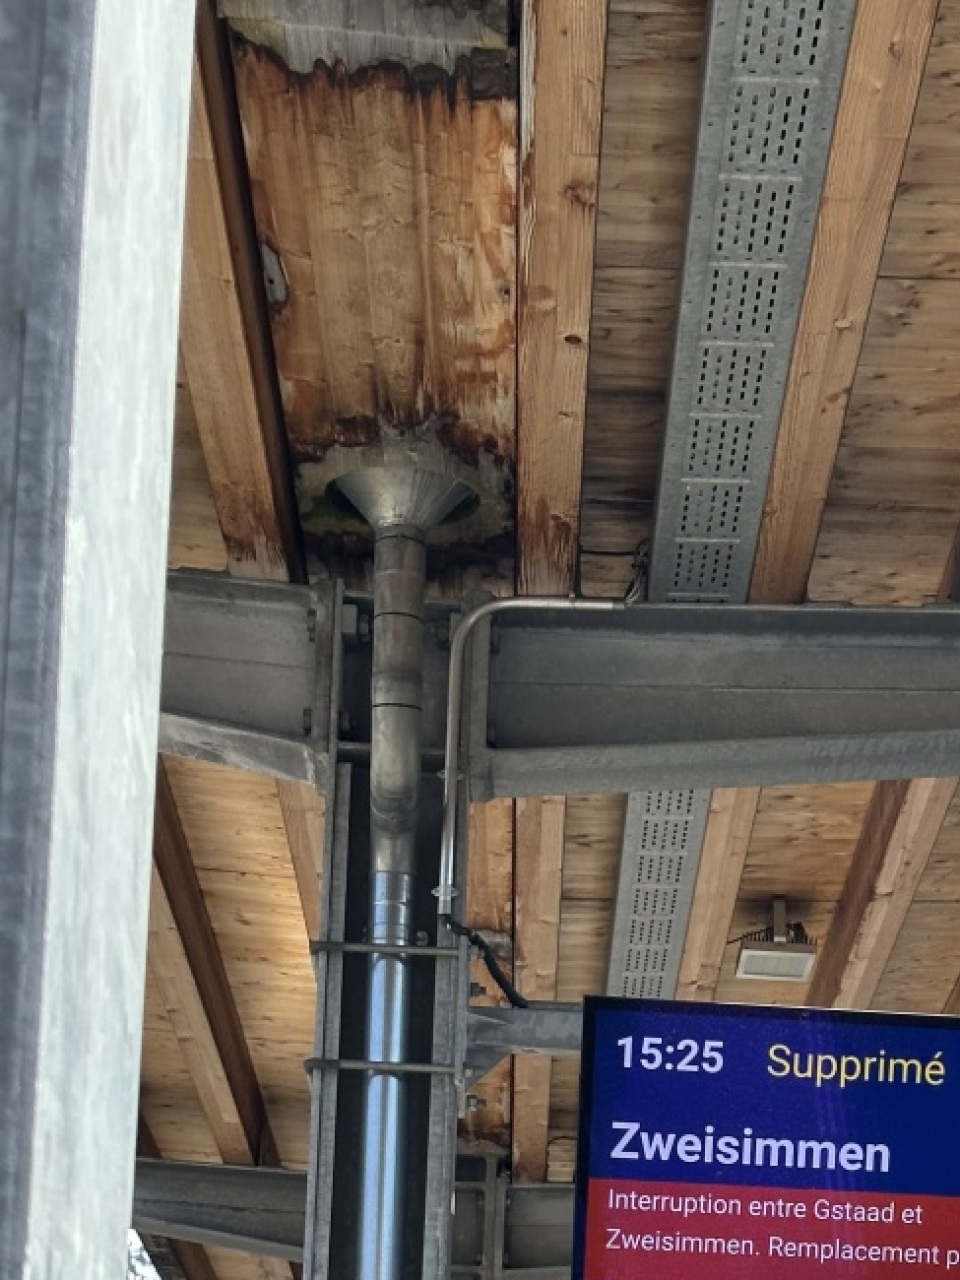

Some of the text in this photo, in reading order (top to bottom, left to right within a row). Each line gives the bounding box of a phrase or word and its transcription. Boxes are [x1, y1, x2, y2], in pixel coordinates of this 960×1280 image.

[617, 1035, 724, 1074] 15:25
[767, 1043, 946, 1088] Supprimé
[609, 1120, 891, 1173] Zweisimmen
[608, 1188, 924, 1224] Interruption entre Gstaad et
[605, 1228, 760, 1256] Zweisimmen.
[768, 1236, 940, 1265] Remplacement
